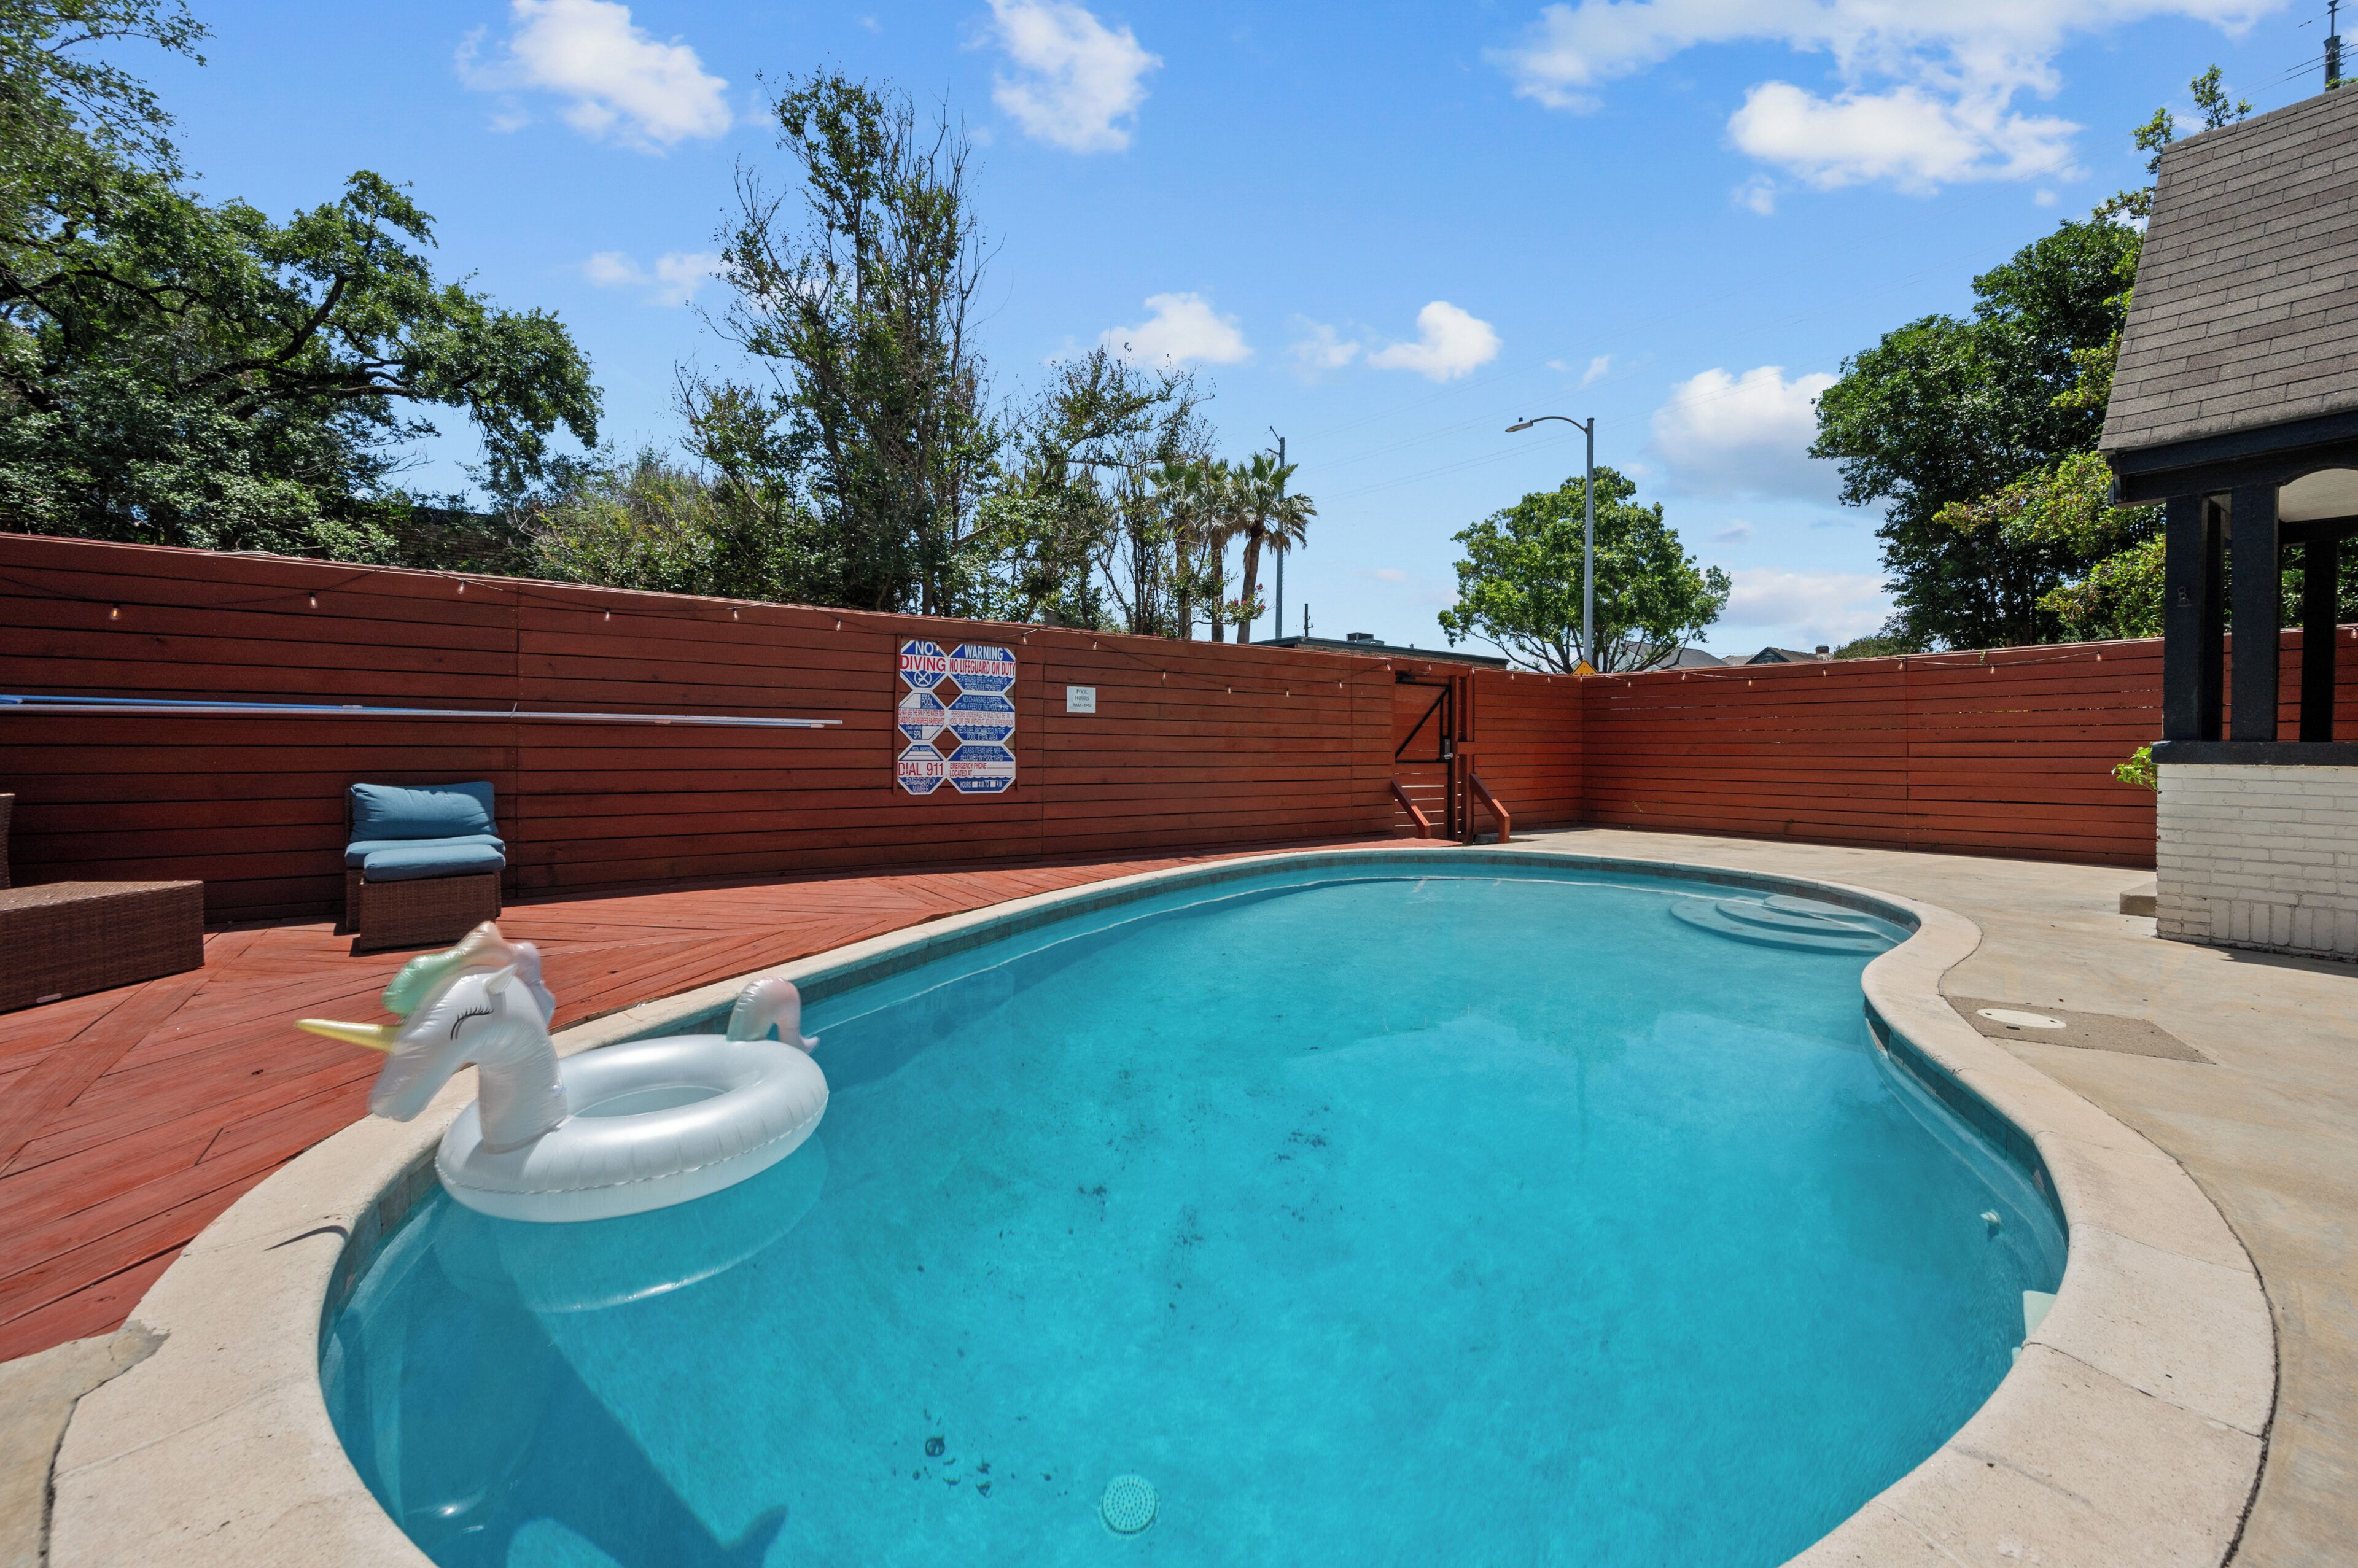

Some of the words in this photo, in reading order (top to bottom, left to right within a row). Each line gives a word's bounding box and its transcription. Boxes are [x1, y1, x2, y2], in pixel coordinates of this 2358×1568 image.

[916, 641, 934, 655] NO
[964, 645, 1003, 660] WARNING
[900, 655, 946, 672] DIVING
[950, 659, 958, 672] NO
[960, 659, 990, 674] LIFEGUARD
[992, 662, 1000, 675] ON
[1002, 663, 1015, 676] DUTY
[898, 762, 922, 776] DIAL
[927, 762, 943, 776] 911
